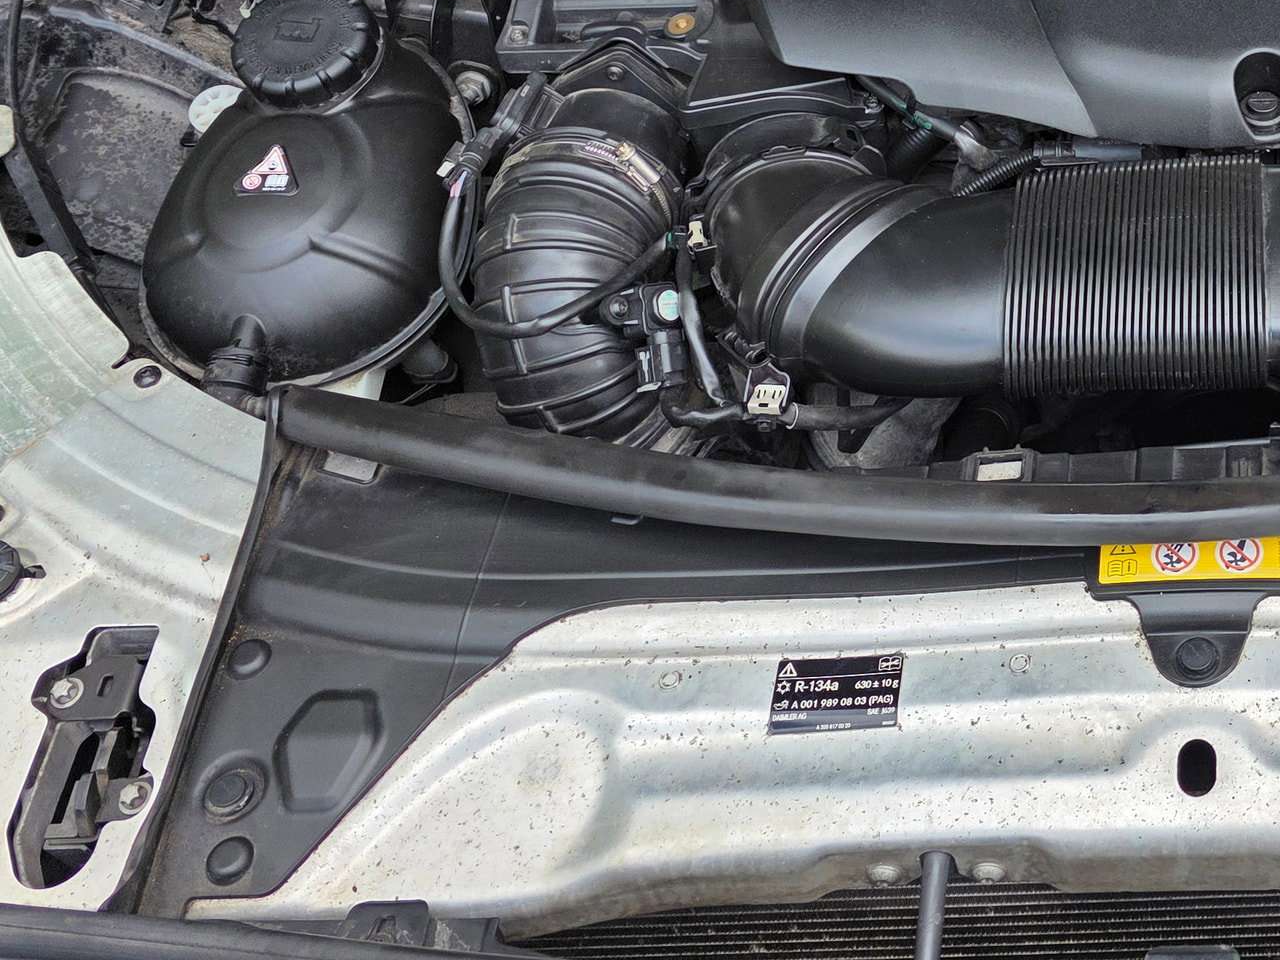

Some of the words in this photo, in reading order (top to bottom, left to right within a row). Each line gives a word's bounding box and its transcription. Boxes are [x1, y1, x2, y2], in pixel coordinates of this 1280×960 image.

[795, 680, 839, 693] R-134a
[855, 680, 871, 690] 630
[882, 679, 891, 688] 10
[791, 701, 799, 709] A
[800, 700, 818, 709] 001
[820, 699, 838, 707] 989
[840, 697, 852, 706] 08
[854, 696, 866, 705] 03
[869, 695, 894, 706] (PAG)
